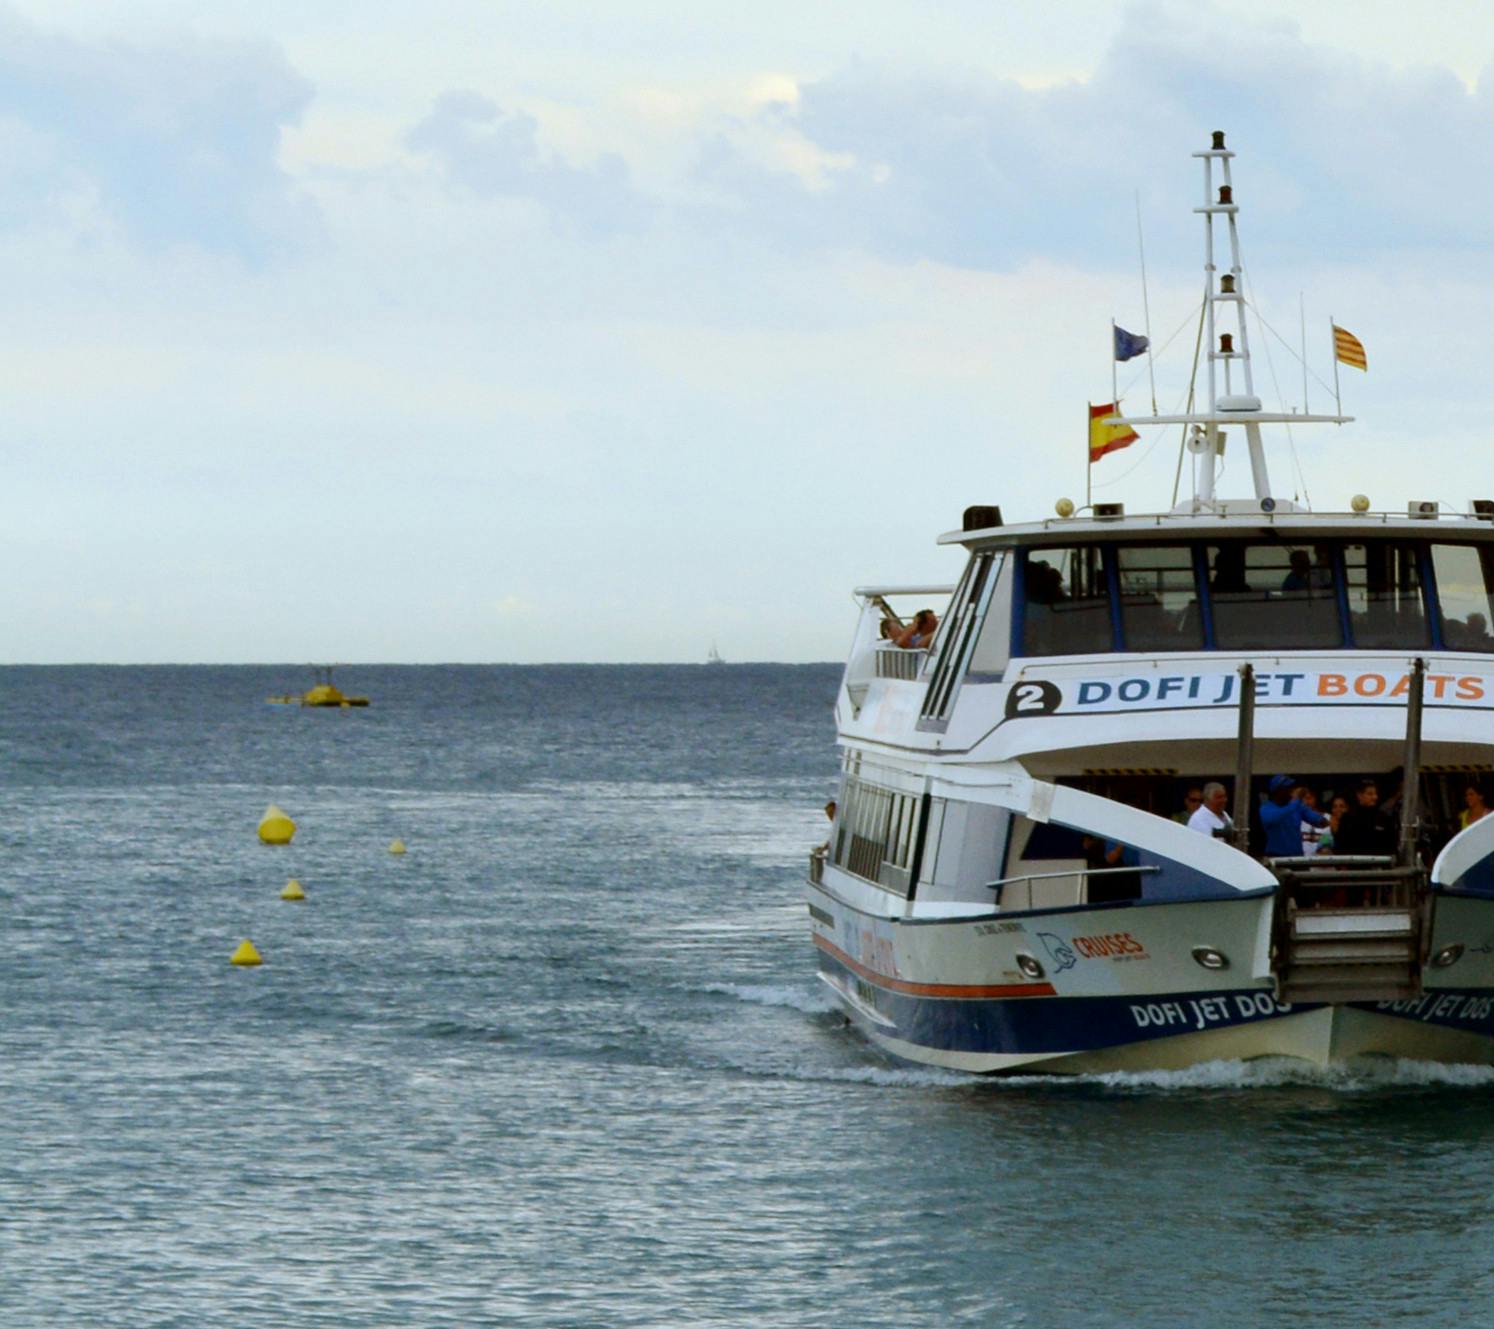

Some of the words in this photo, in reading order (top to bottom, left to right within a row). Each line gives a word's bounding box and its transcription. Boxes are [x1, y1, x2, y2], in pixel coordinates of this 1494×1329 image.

[1015, 685, 1045, 712] 2
[1077, 676, 1201, 704] DOFI
[1213, 674, 1305, 703] JET
[1316, 673, 1485, 700] BOATS
[1073, 933, 1143, 958] CRUISES
[1131, 1002, 1187, 1027] DOFI
[1189, 996, 1230, 1029] JET
[1233, 992, 1293, 1017] DOS
[1422, 993, 1465, 1021] JET
